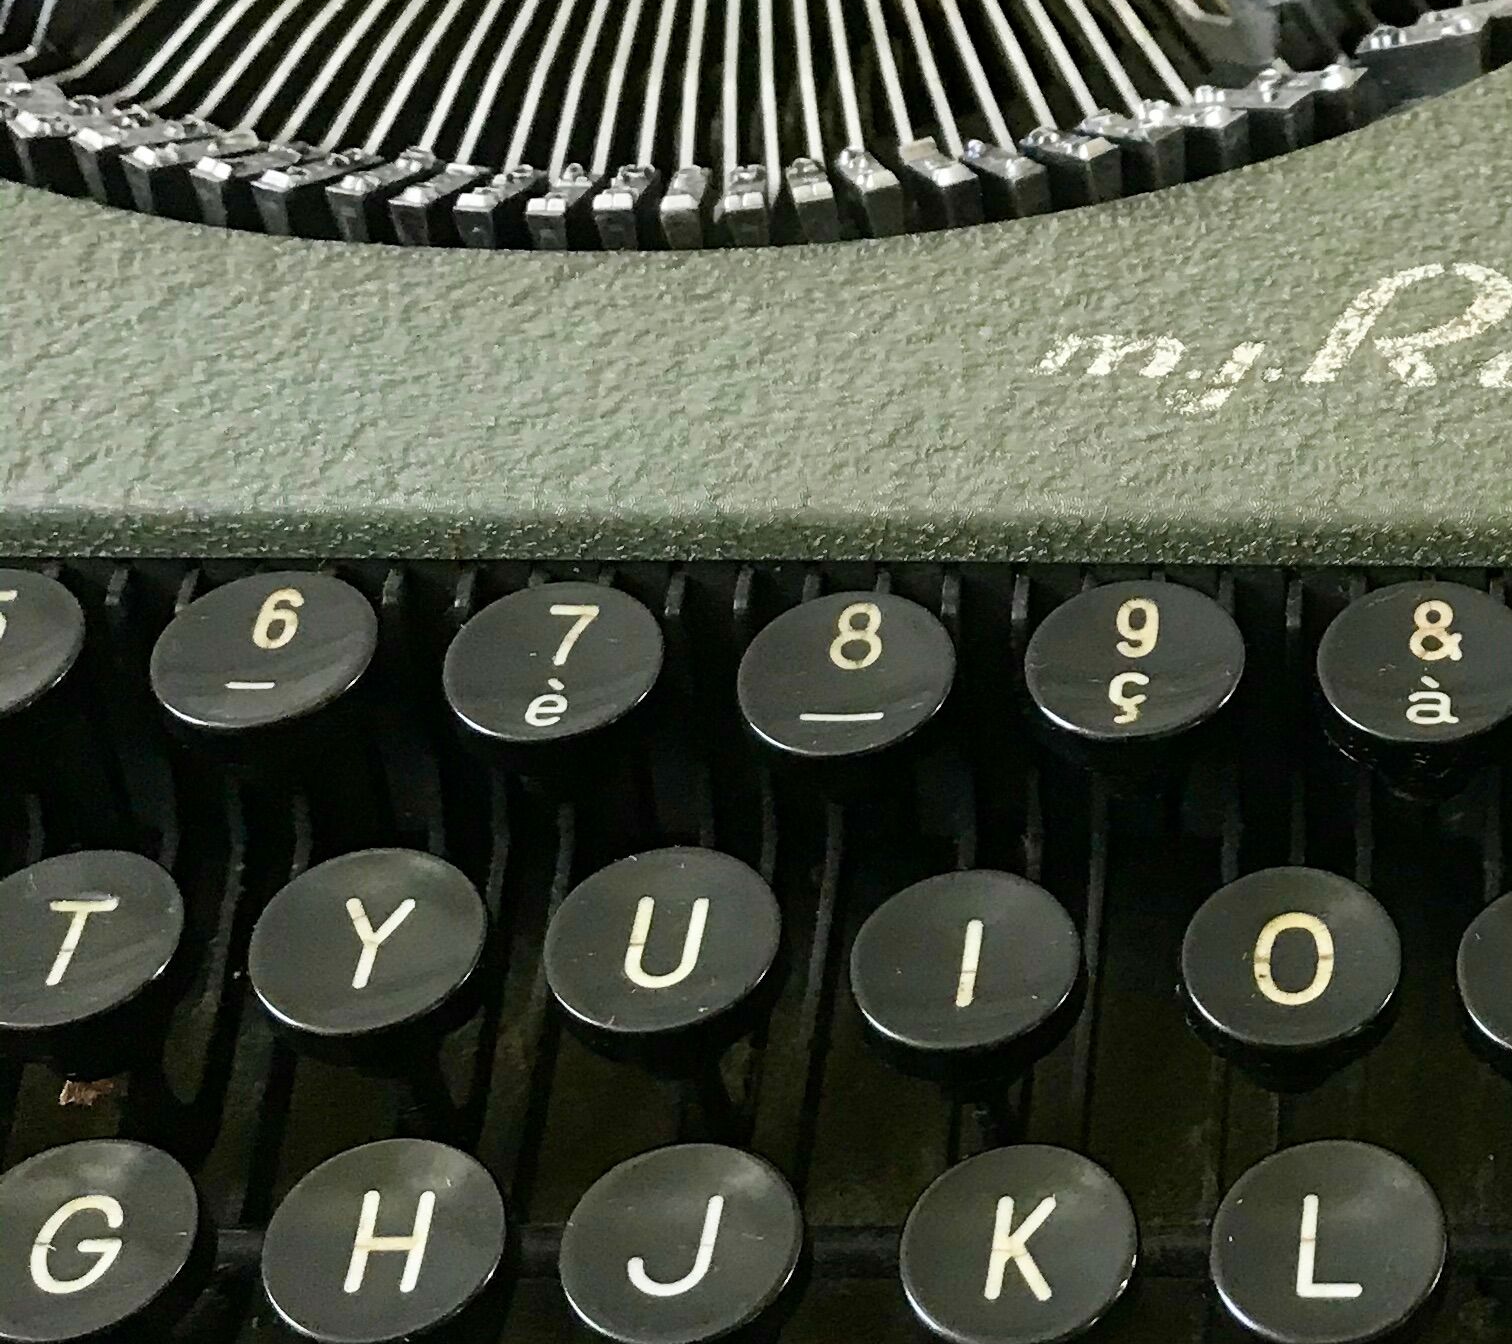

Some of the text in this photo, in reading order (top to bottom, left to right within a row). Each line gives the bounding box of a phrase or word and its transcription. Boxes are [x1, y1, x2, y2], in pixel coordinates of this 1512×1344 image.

[252, 588, 305, 650] 6
[549, 604, 600, 667] 7
[829, 602, 883, 670] 8
[1115, 598, 1160, 659] 9
[1409, 600, 1463, 662] &
[524, 677, 568, 727] è
[1108, 672, 1150, 725] ç
[1405, 675, 1460, 725] à
[44, 893, 120, 987] T
[345, 897, 416, 990] Y
[623, 896, 710, 989] U
[955, 919, 985, 1008] I
[1253, 912, 1335, 1006] O
[27, 1194, 124, 1295] G
[343, 1190, 437, 1294] H
[627, 1193, 725, 1298] J
[983, 1193, 1057, 1302] K
[1295, 1194, 1363, 1300] L
